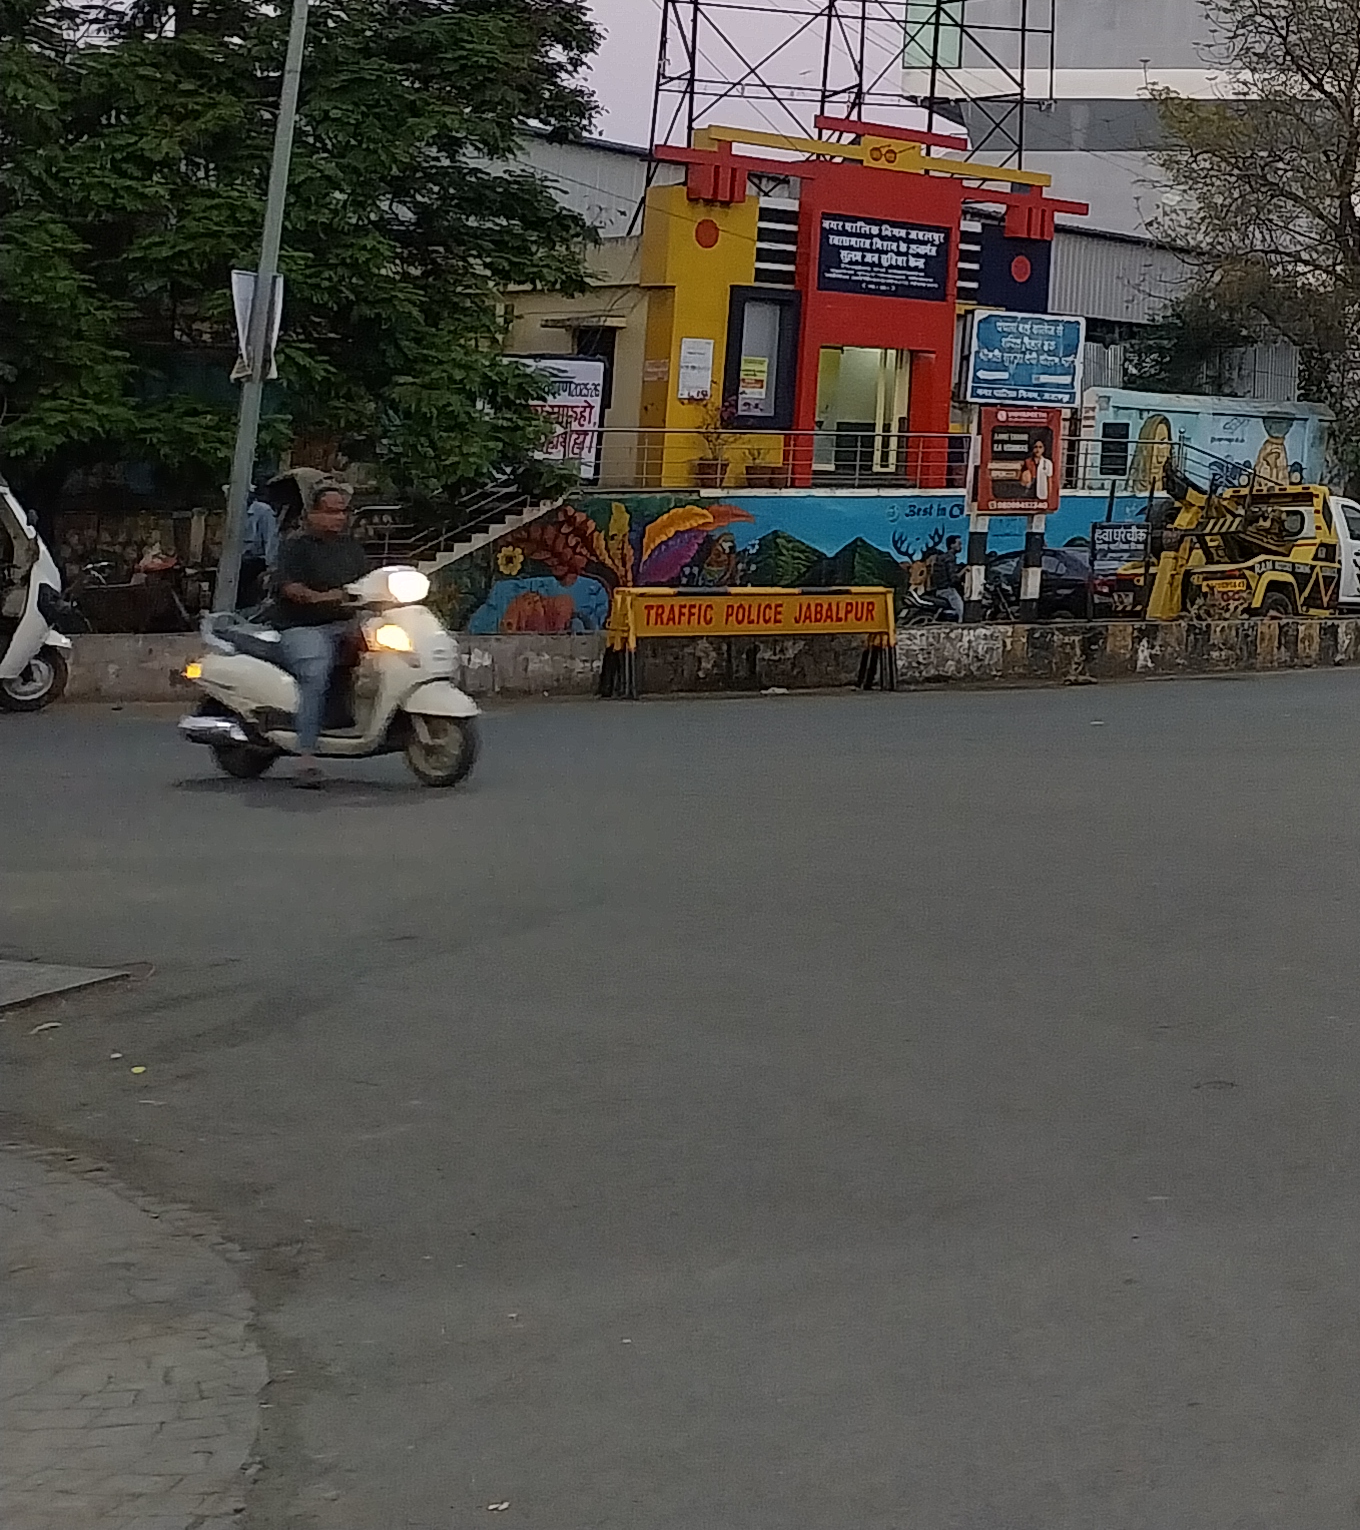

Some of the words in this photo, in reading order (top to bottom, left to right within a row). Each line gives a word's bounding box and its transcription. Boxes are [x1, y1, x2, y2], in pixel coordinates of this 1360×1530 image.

[644, 603, 714, 626] TRAFFIC
[725, 602, 784, 625] POLICE
[793, 600, 875, 624] JABALPUR
